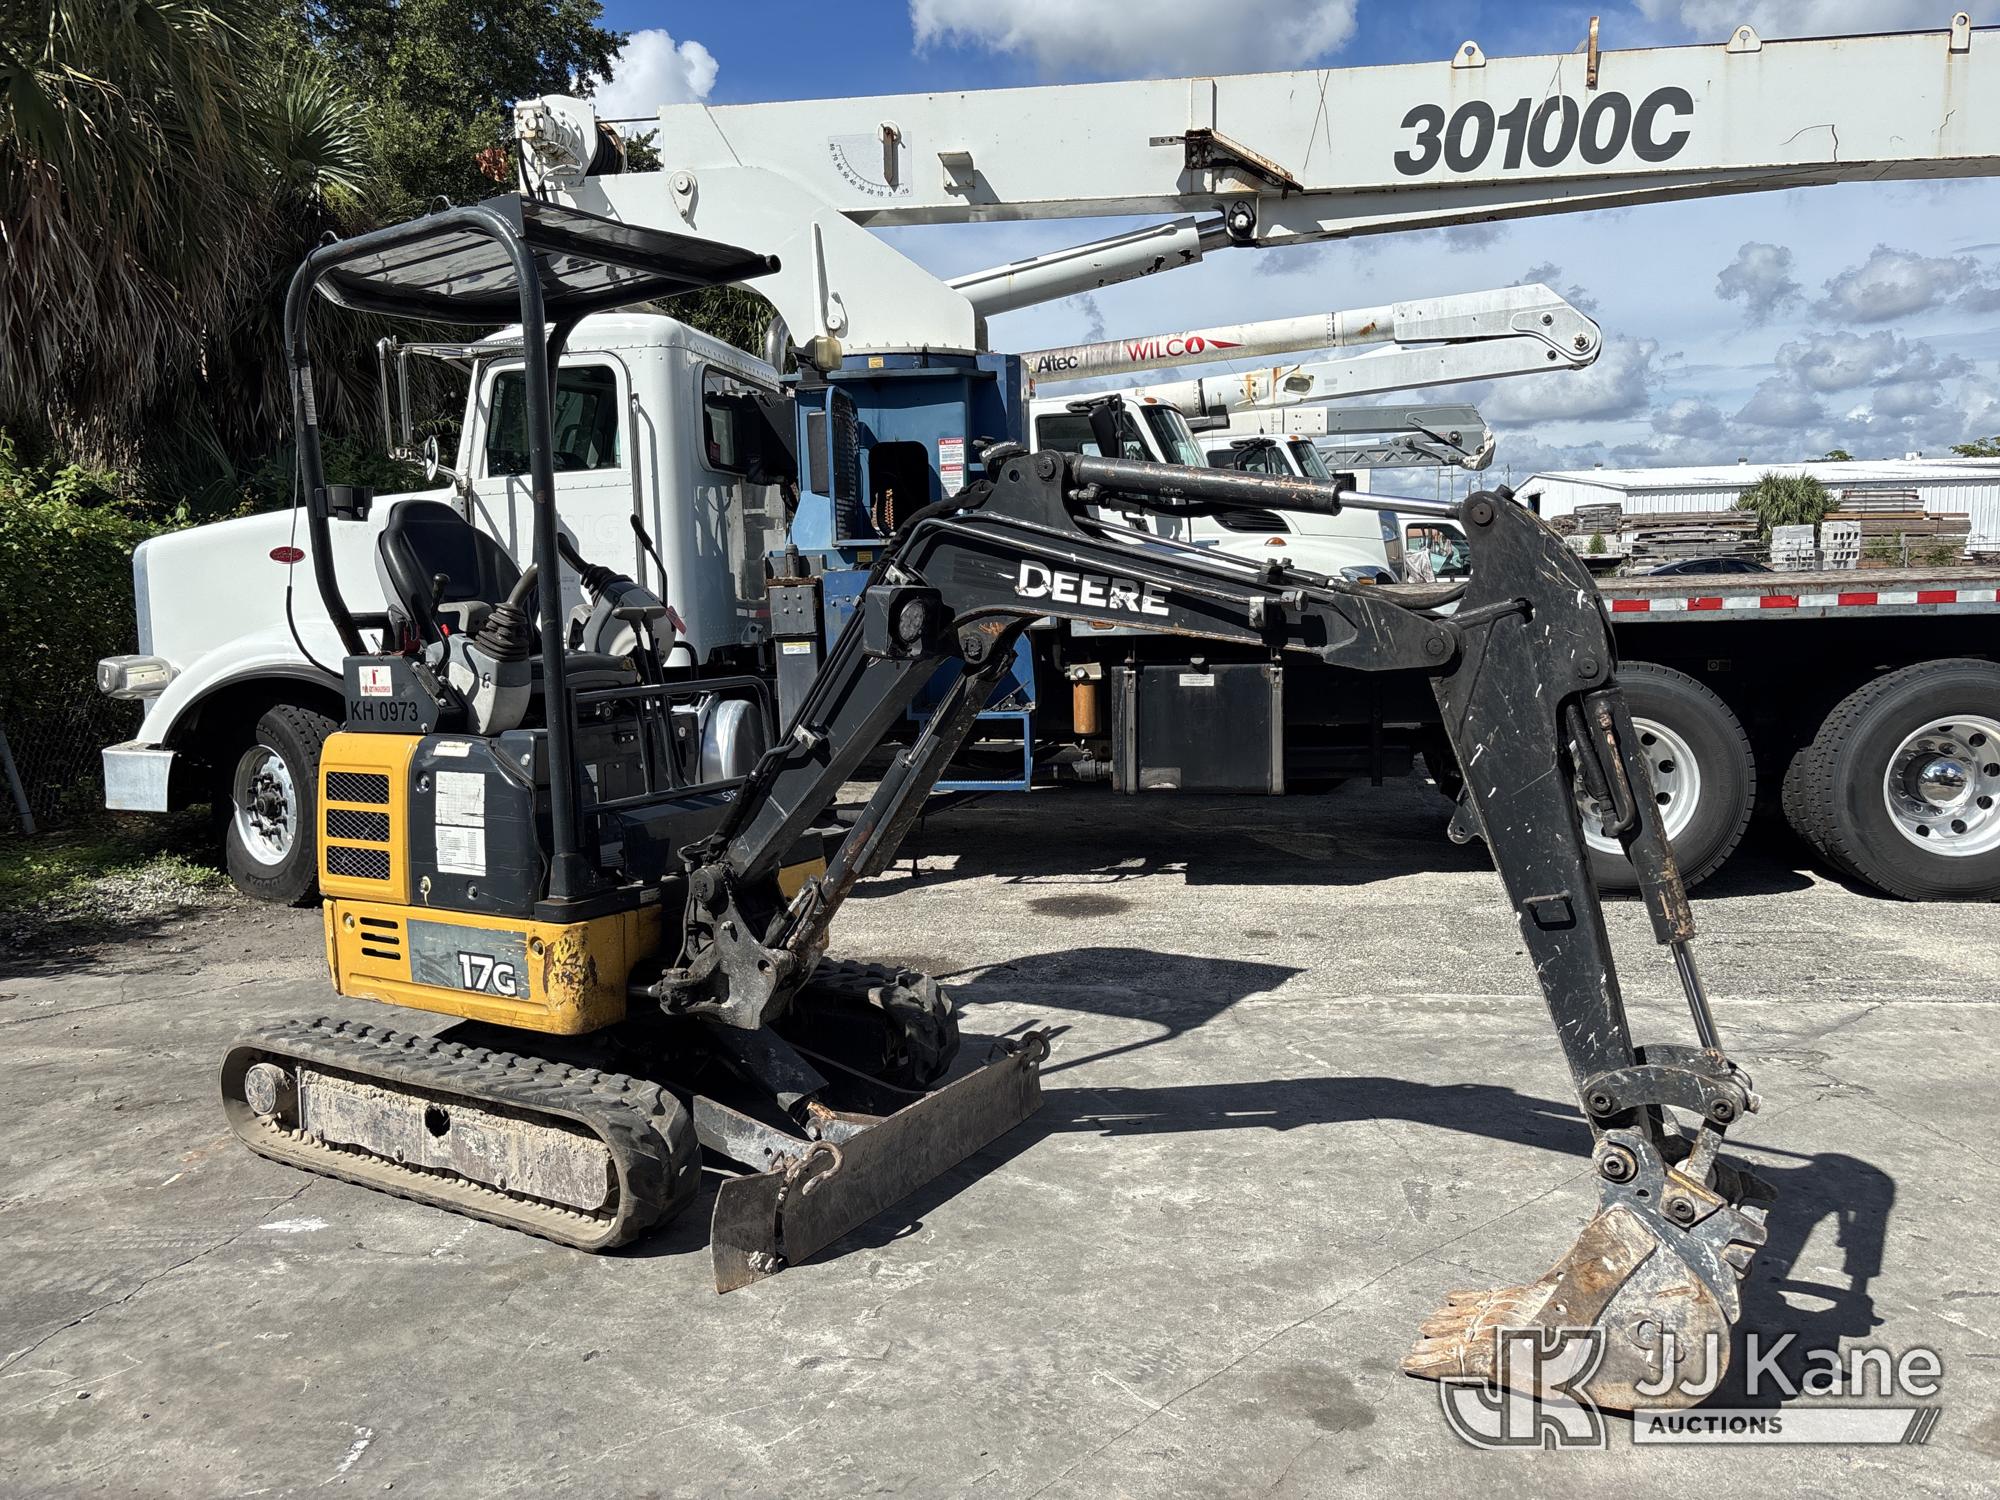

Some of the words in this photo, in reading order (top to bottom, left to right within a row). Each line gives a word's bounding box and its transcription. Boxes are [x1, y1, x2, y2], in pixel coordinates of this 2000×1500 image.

[1393, 86, 1694, 176] 30100C
[1038, 355, 1078, 373] Altec
[1127, 336, 1205, 361] WILCO
[1016, 560, 1172, 616] DEERE
[350, 701, 374, 720] KH
[380, 701, 418, 721] 0973
[457, 951, 517, 996] 17G
